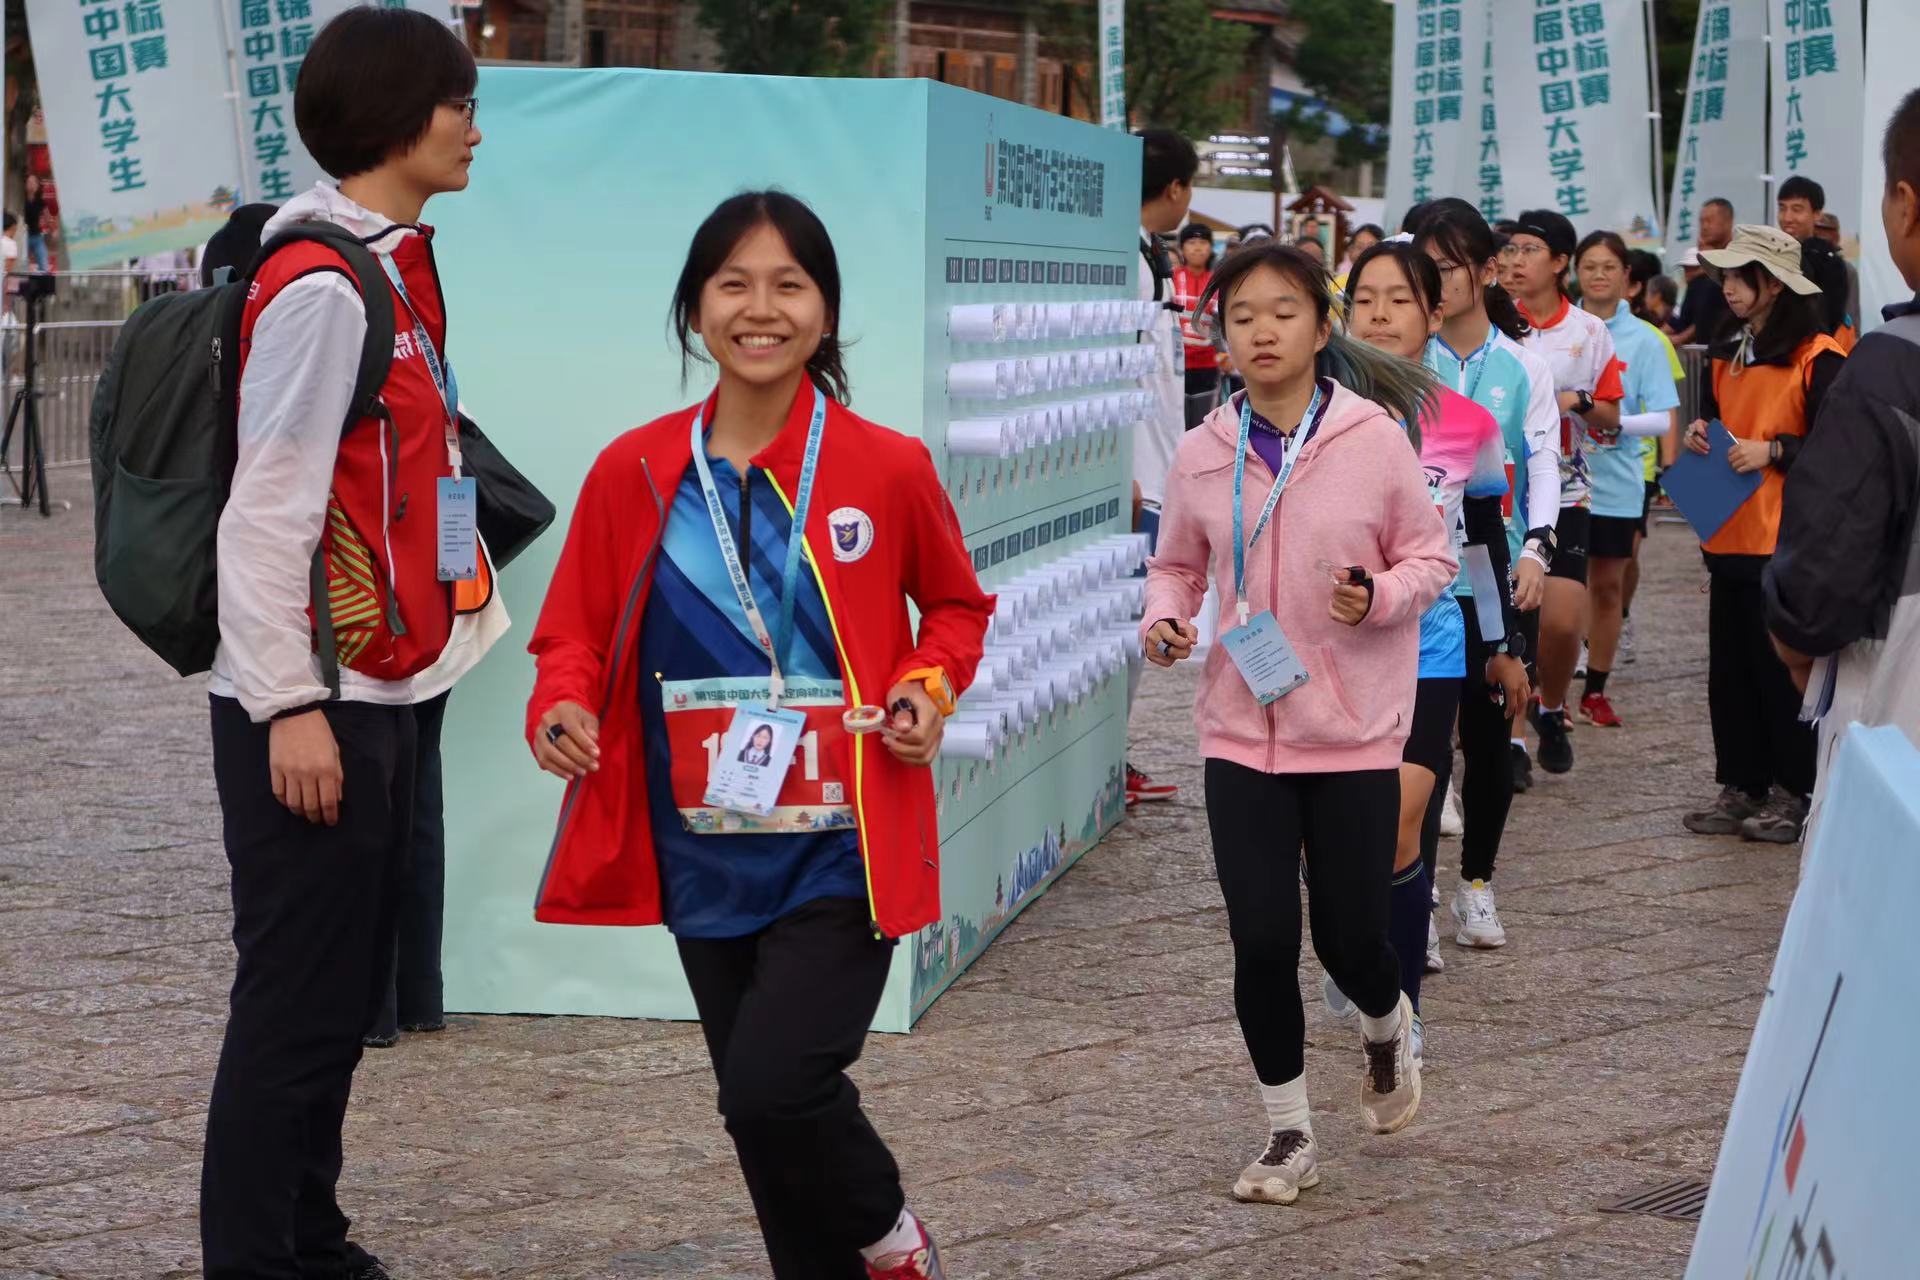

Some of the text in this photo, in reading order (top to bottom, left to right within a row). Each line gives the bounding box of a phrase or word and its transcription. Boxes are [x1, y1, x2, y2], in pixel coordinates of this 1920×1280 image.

[124, 0, 169, 73] 标赛
[1437, 0, 1464, 121] 向锦标赛
[1568, 0, 1610, 108] 锦标赛
[79, 0, 147, 192] 中国大学生
[1533, 0, 1590, 216] 届中国大学生
[702, 730, 820, 782] 11
